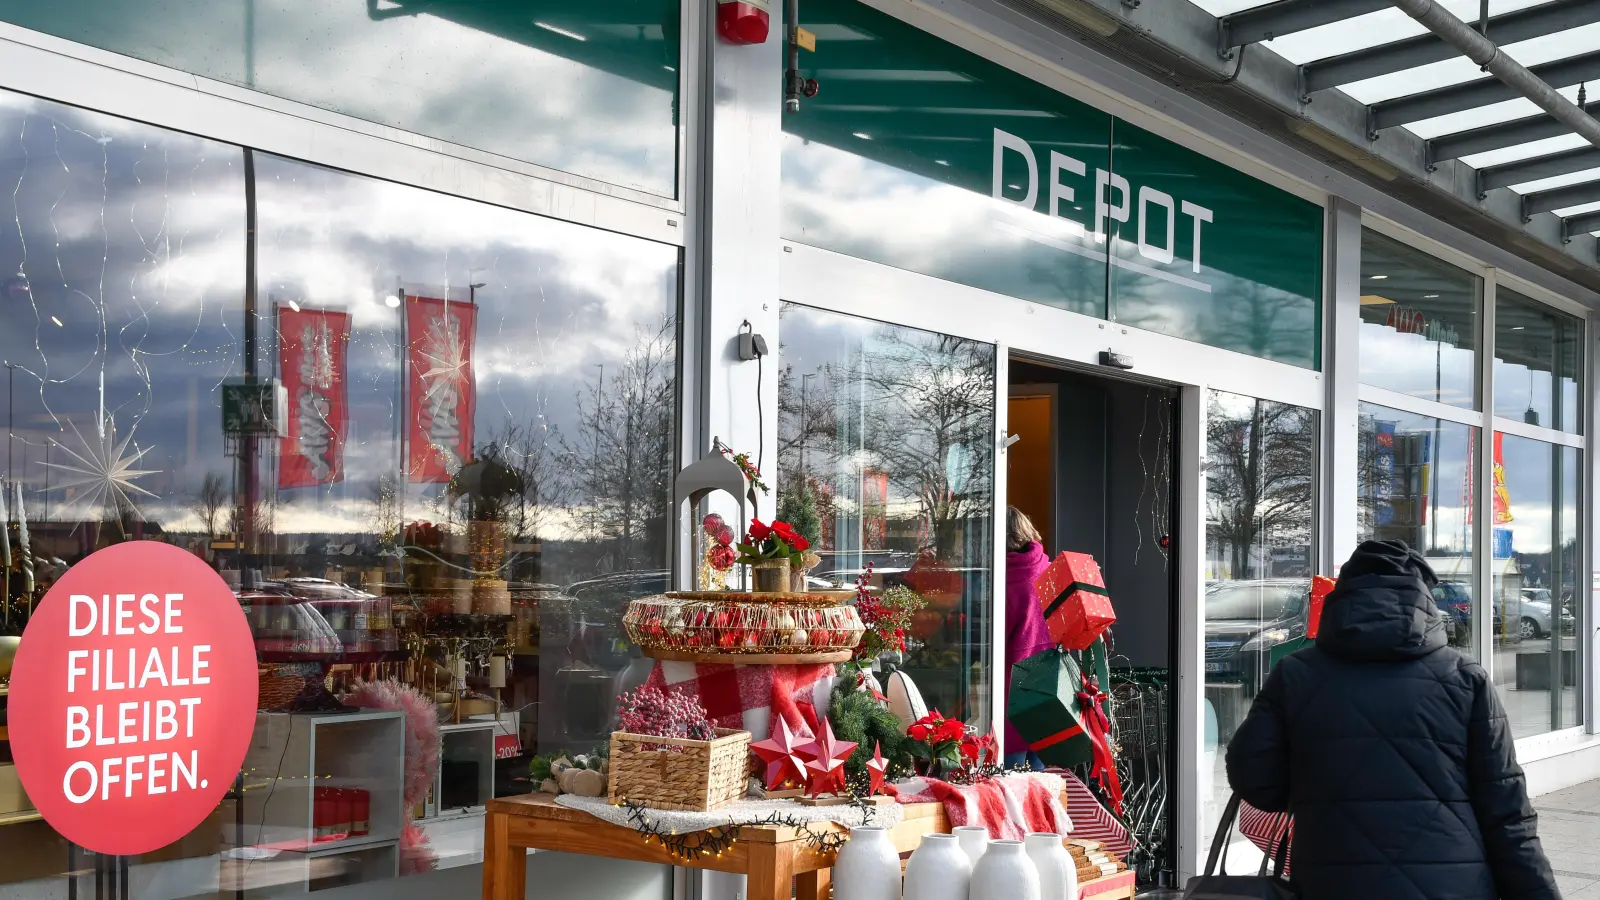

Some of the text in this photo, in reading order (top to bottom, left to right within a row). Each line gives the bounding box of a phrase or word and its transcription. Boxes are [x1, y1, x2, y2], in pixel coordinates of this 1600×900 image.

[992, 127, 1214, 274] DEPOT
[68, 593, 184, 637] DIESE
[67, 644, 212, 693] FILIALE
[66, 697, 202, 749] BLEIBT
[63, 749, 209, 804] OFFEN.
